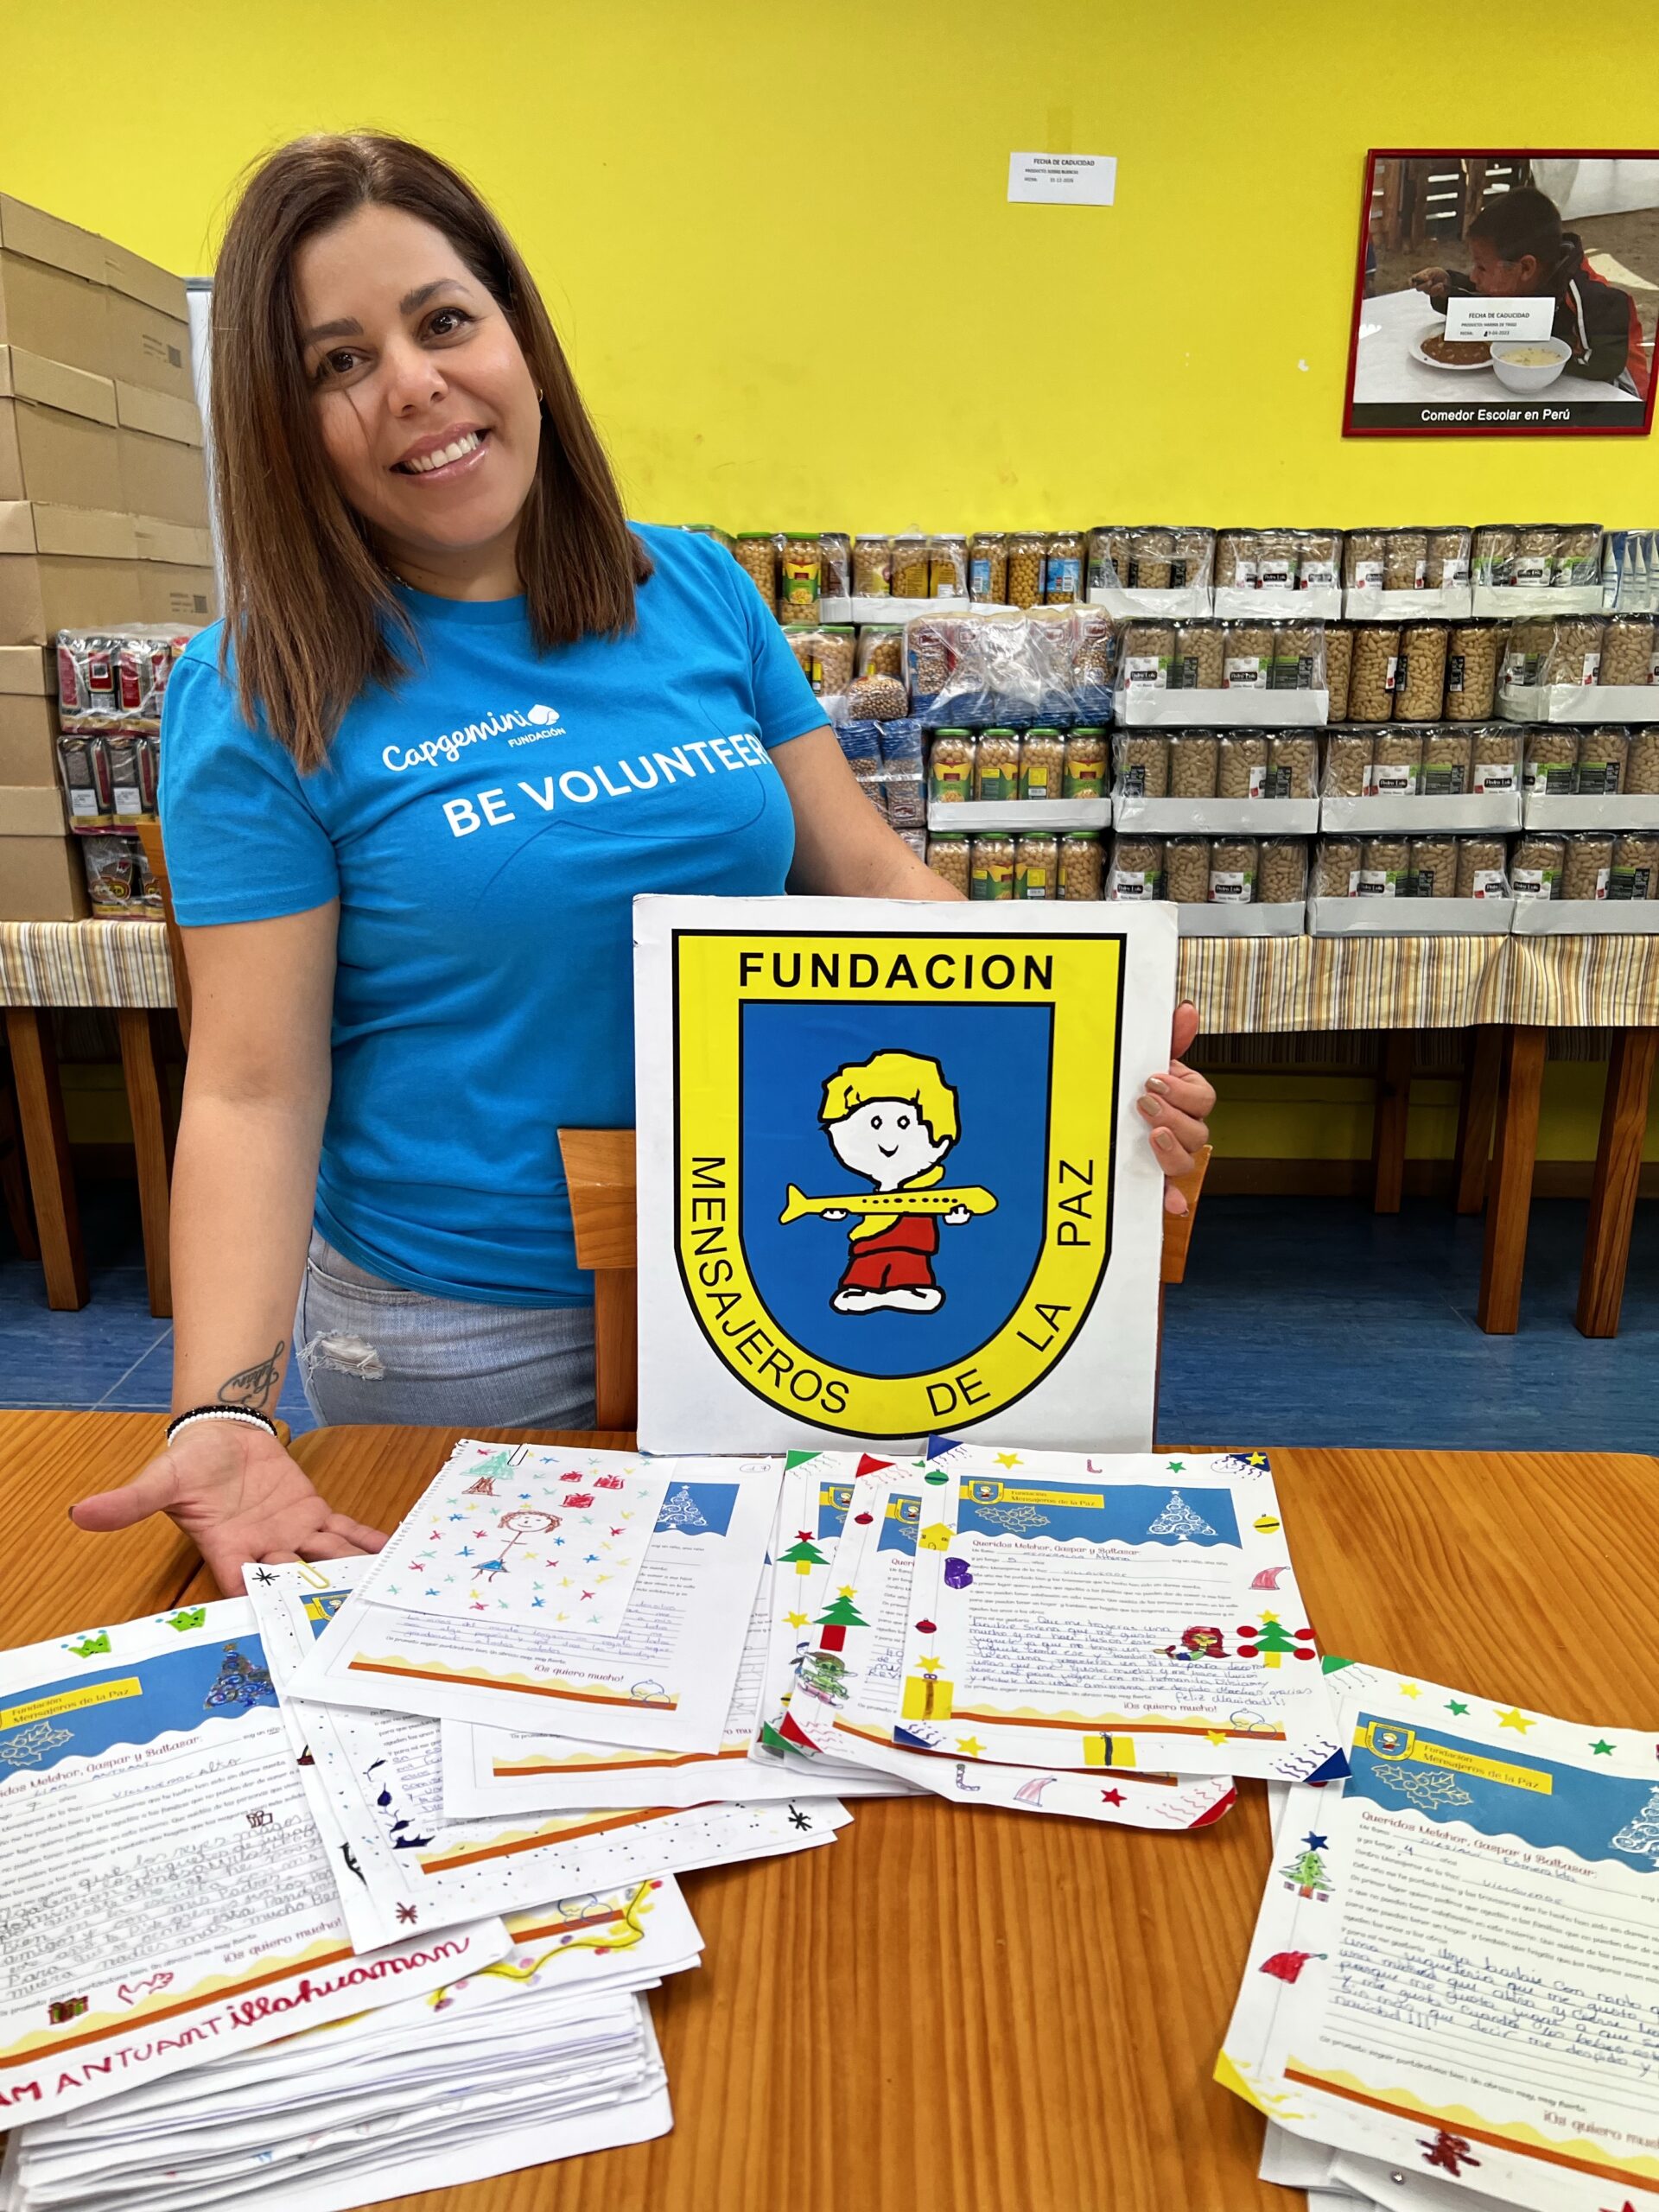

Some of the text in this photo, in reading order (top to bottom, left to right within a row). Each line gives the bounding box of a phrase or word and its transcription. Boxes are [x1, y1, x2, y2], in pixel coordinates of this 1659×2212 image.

[1421, 409, 1571, 422] Comedor Escolar en Perú
[382, 710, 531, 772] Capgemini
[508, 727, 566, 748] FUNDACIÓN
[442, 733, 772, 838] BE VOLUNTEER
[739, 951, 1054, 990] FUNDACION
[691, 1156, 1094, 1417] MENSAJEROS DE LA PAZ
[1011, 1496, 1056, 1504] Mensajeros
[972, 1539, 1013, 1548] Queridos
[1014, 1541, 1052, 1553] Melchor,
[1054, 1545, 1087, 1556] Gaspar
[552, 1667, 584, 1679] quiero
[587, 1670, 624, 1682] mucho!
[12, 1696, 62, 1716] Fundación
[13, 1689, 130, 1725] Mensajeros de la Paz
[1143, 1703, 1177, 1712] quiero
[30, 1767, 84, 1789] Melchor,
[86, 1755, 131, 1774] Gaspar
[135, 1753, 142, 1763] y
[1423, 1752, 1540, 1789] Mensajeros de la Paz
[1424, 1745, 1473, 1764] Fundación
[1361, 1809, 1415, 1832] Queridos
[1418, 1824, 1471, 1847] Melchor,
[1472, 1839, 1519, 1860] Gaspar
[1522, 1853, 1530, 1862] y
[249, 1936, 292, 1955] quiero
[296, 1916, 343, 1940] mucho!
[57, 2016, 224, 2098] ANTUANT
[1571, 2120, 1622, 2140] quiero
